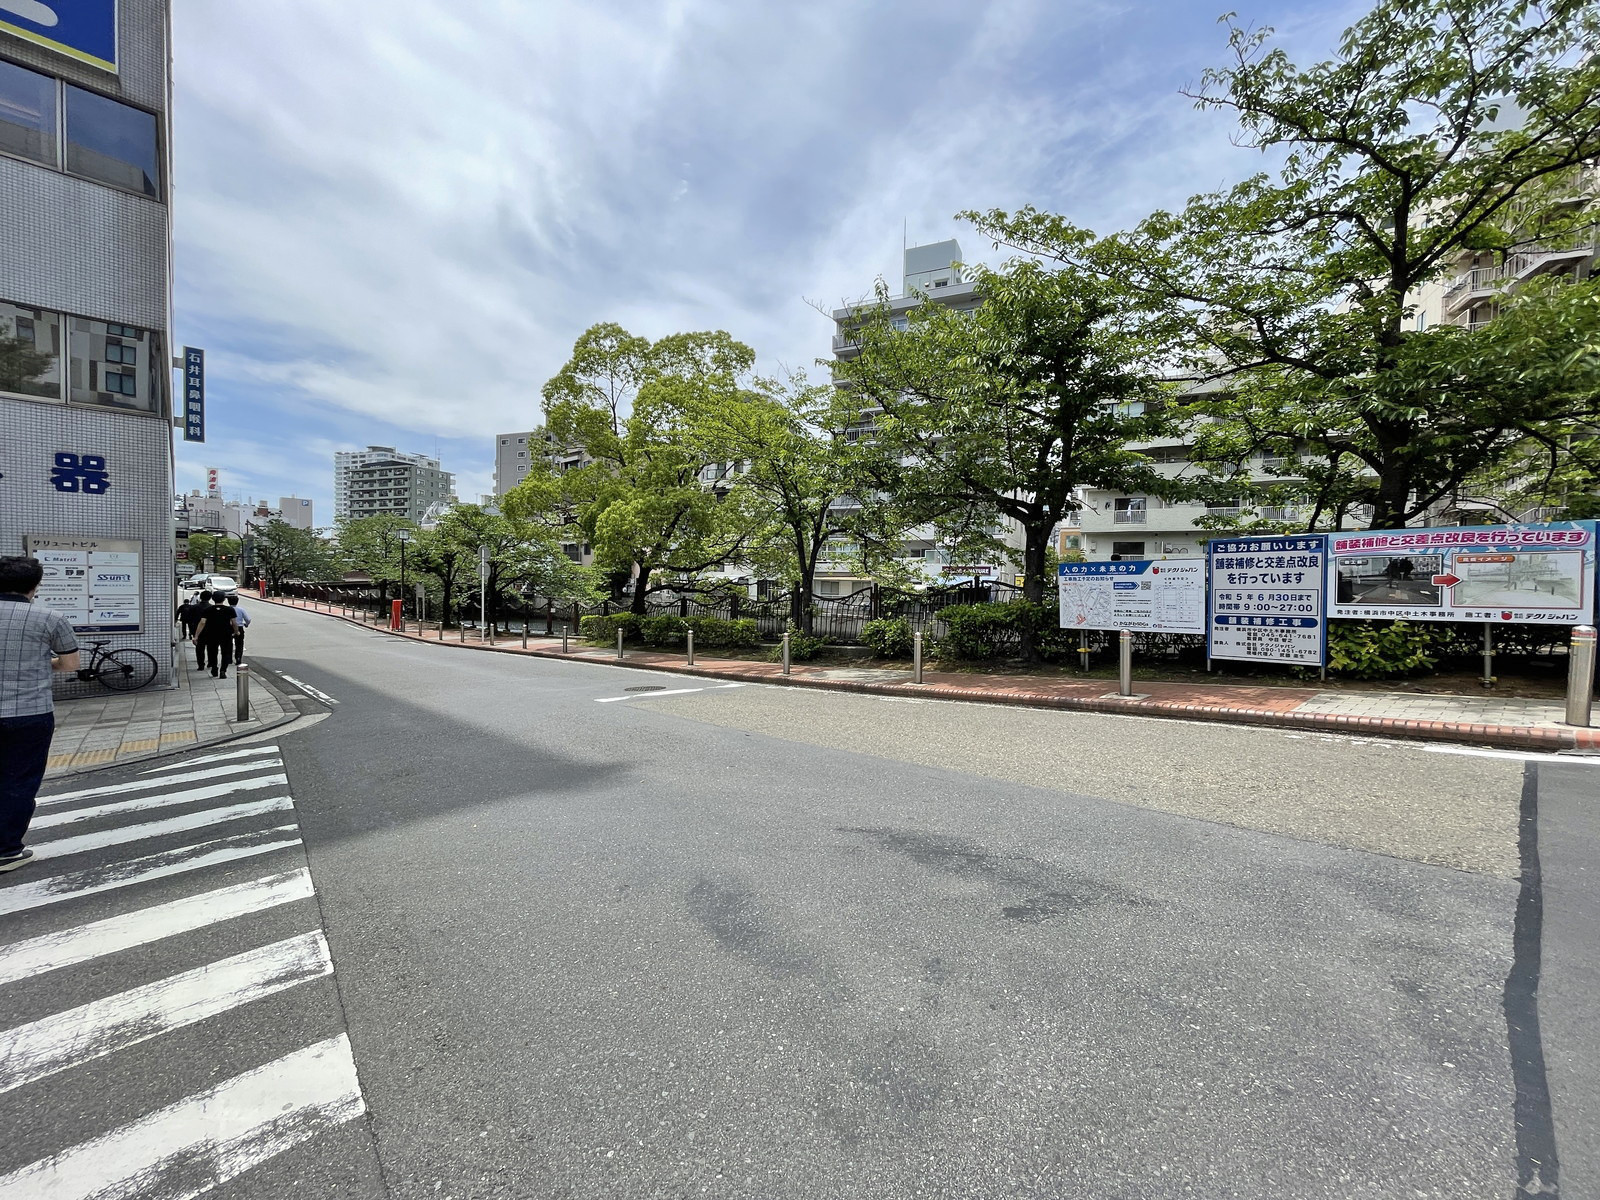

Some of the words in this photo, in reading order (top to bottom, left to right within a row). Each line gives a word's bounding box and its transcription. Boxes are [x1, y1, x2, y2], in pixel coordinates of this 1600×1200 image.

[188, 352, 201, 436] 石井耳鼻咽喉科
[33, 540, 98, 548] サリュートビル
[1217, 540, 1319, 552] ご協力お願いします
[1335, 531, 1585, 551] 舗装補修と交差点改良を行っています
[1215, 556, 1319, 570] 舗装補修と交差点改良
[1227, 572, 1305, 584] を行っています
[1228, 617, 1302, 626] 舗装補修工事
